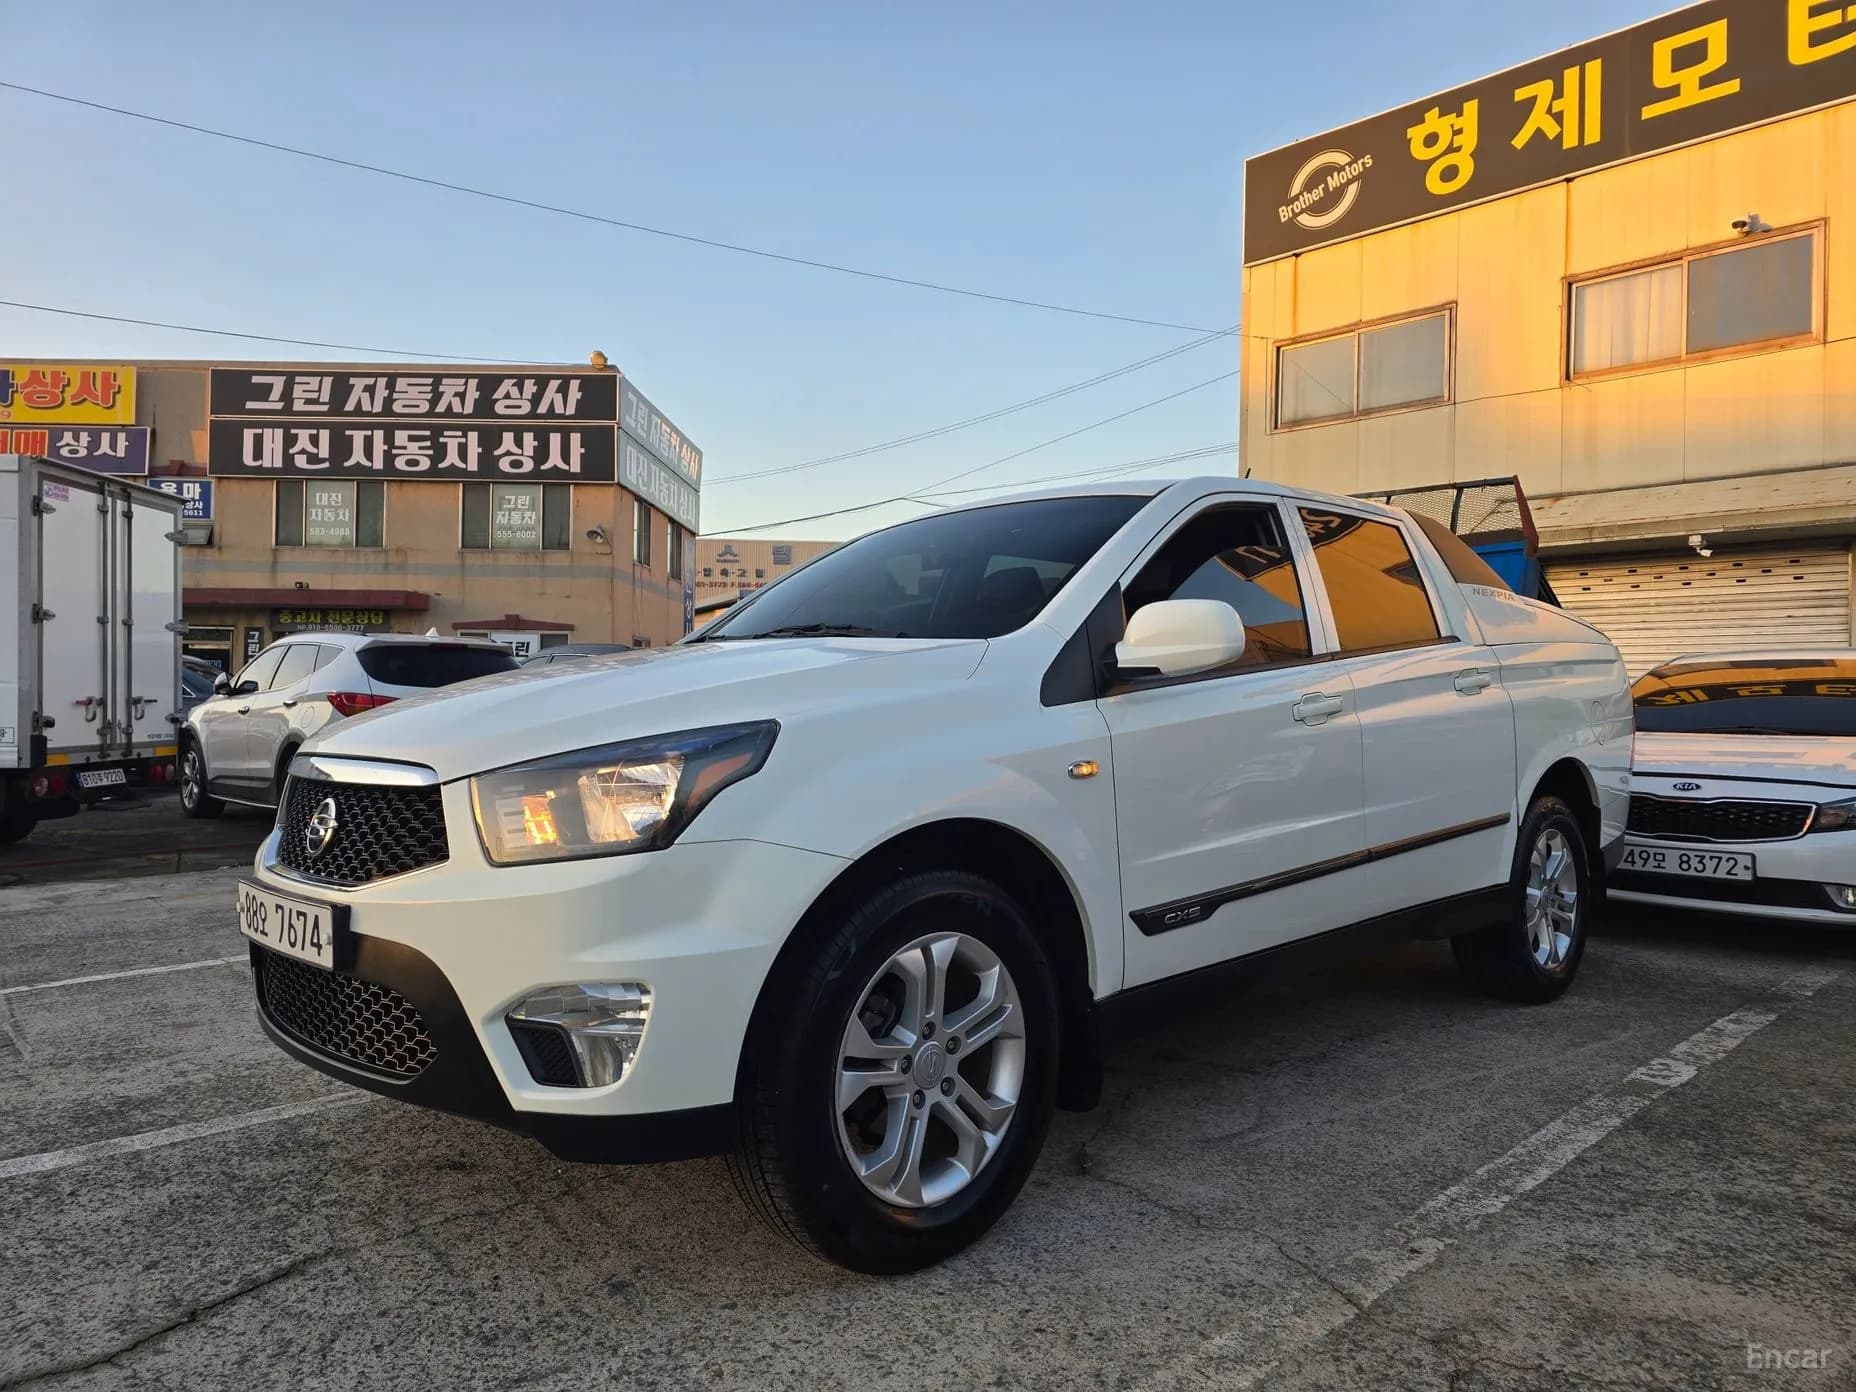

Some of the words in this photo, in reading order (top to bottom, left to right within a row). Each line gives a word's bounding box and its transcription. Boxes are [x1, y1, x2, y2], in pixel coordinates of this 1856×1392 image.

[1278, 183, 1325, 223] Brother
[1326, 154, 1373, 192] Motors
[245, 375, 334, 412] 그린
[343, 376, 480, 415] 자동차
[492, 378, 583, 416] 상사
[625, 391, 649, 440] 그린
[0, 430, 48, 457] 매
[56, 431, 129, 458] 상사
[242, 427, 330, 470] 대진
[343, 429, 482, 473] 자동차
[493, 431, 586, 474] 상사
[316, 492, 342, 506] 대진
[503, 495, 530, 509] 그린
[309, 508, 349, 521] 자동차
[495, 511, 536, 525] 자동차
[1472, 586, 1515, 602] NEXPIA
[1675, 782, 1698, 791] KIA
[1623, 848, 1667, 870] 49모
[1678, 852, 1739, 877] 8372
[243, 890, 269, 938] 88오
[274, 903, 323, 957] 7674
